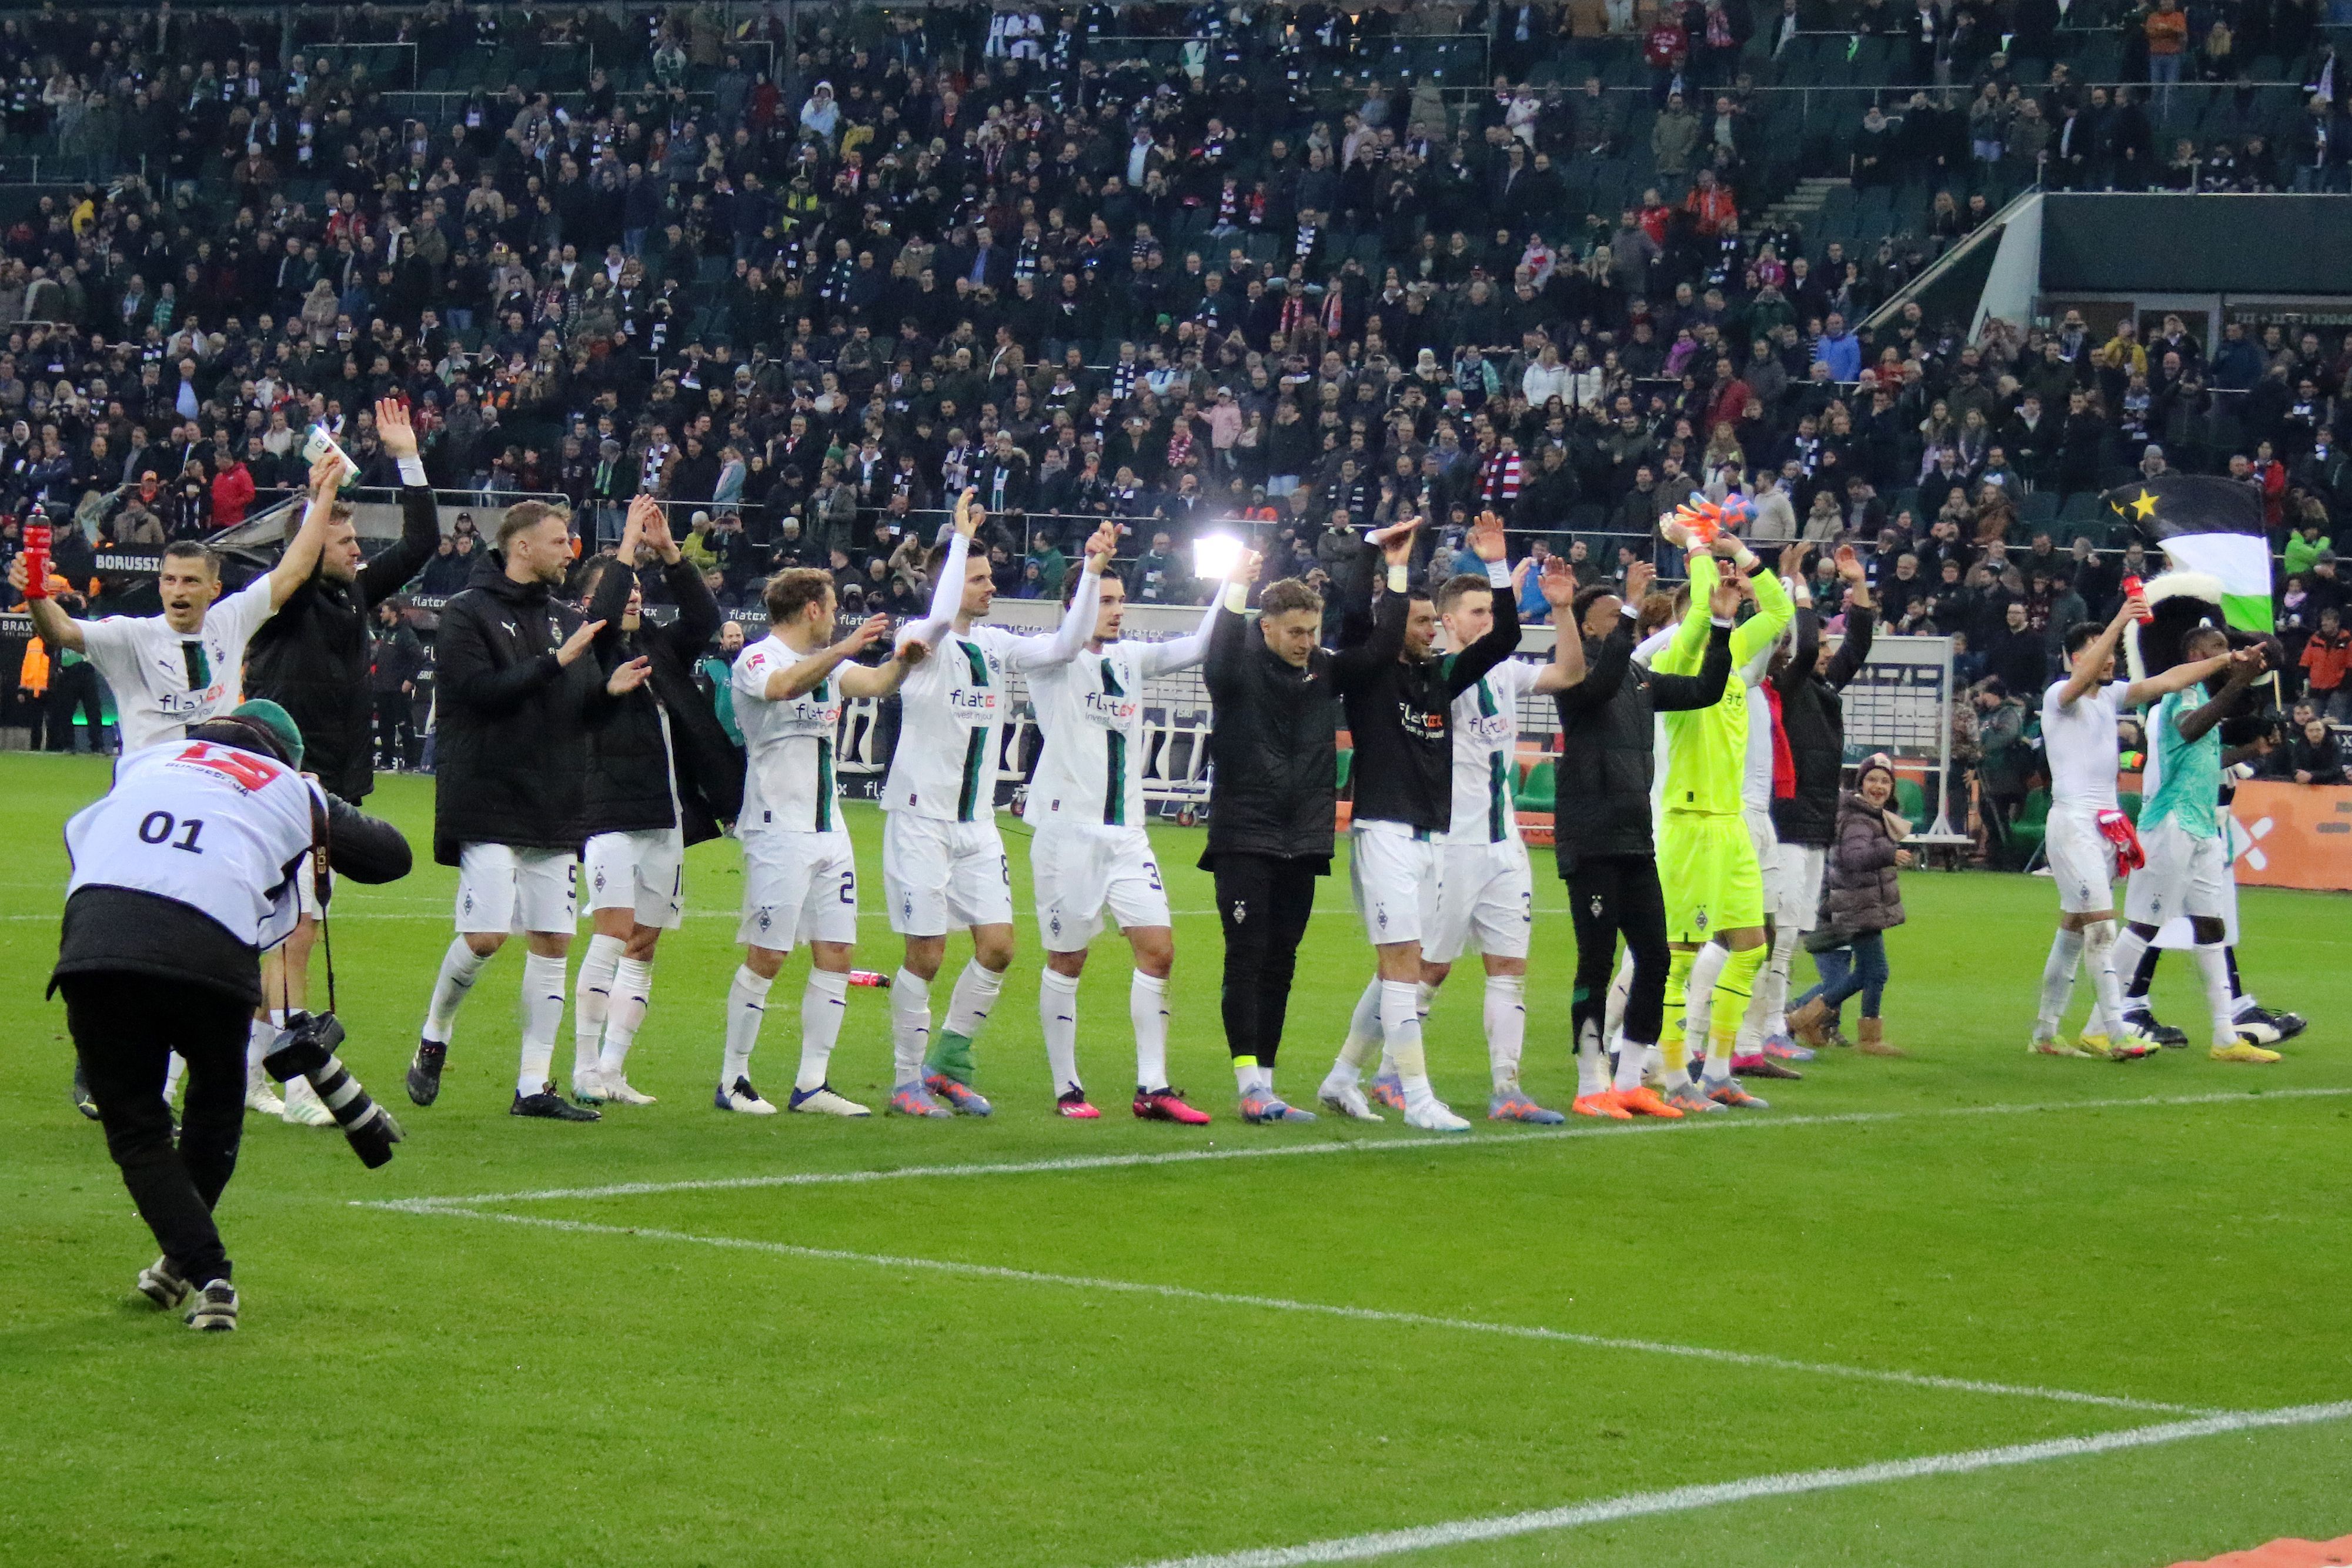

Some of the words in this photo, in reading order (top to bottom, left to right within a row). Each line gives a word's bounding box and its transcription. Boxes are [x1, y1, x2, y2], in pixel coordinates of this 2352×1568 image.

[2, 620, 33, 632] BRAX
[840, 614, 870, 626] flat
[950, 690, 995, 707] flate
[139, 810, 204, 854] 01
[840, 871, 854, 904] 2
